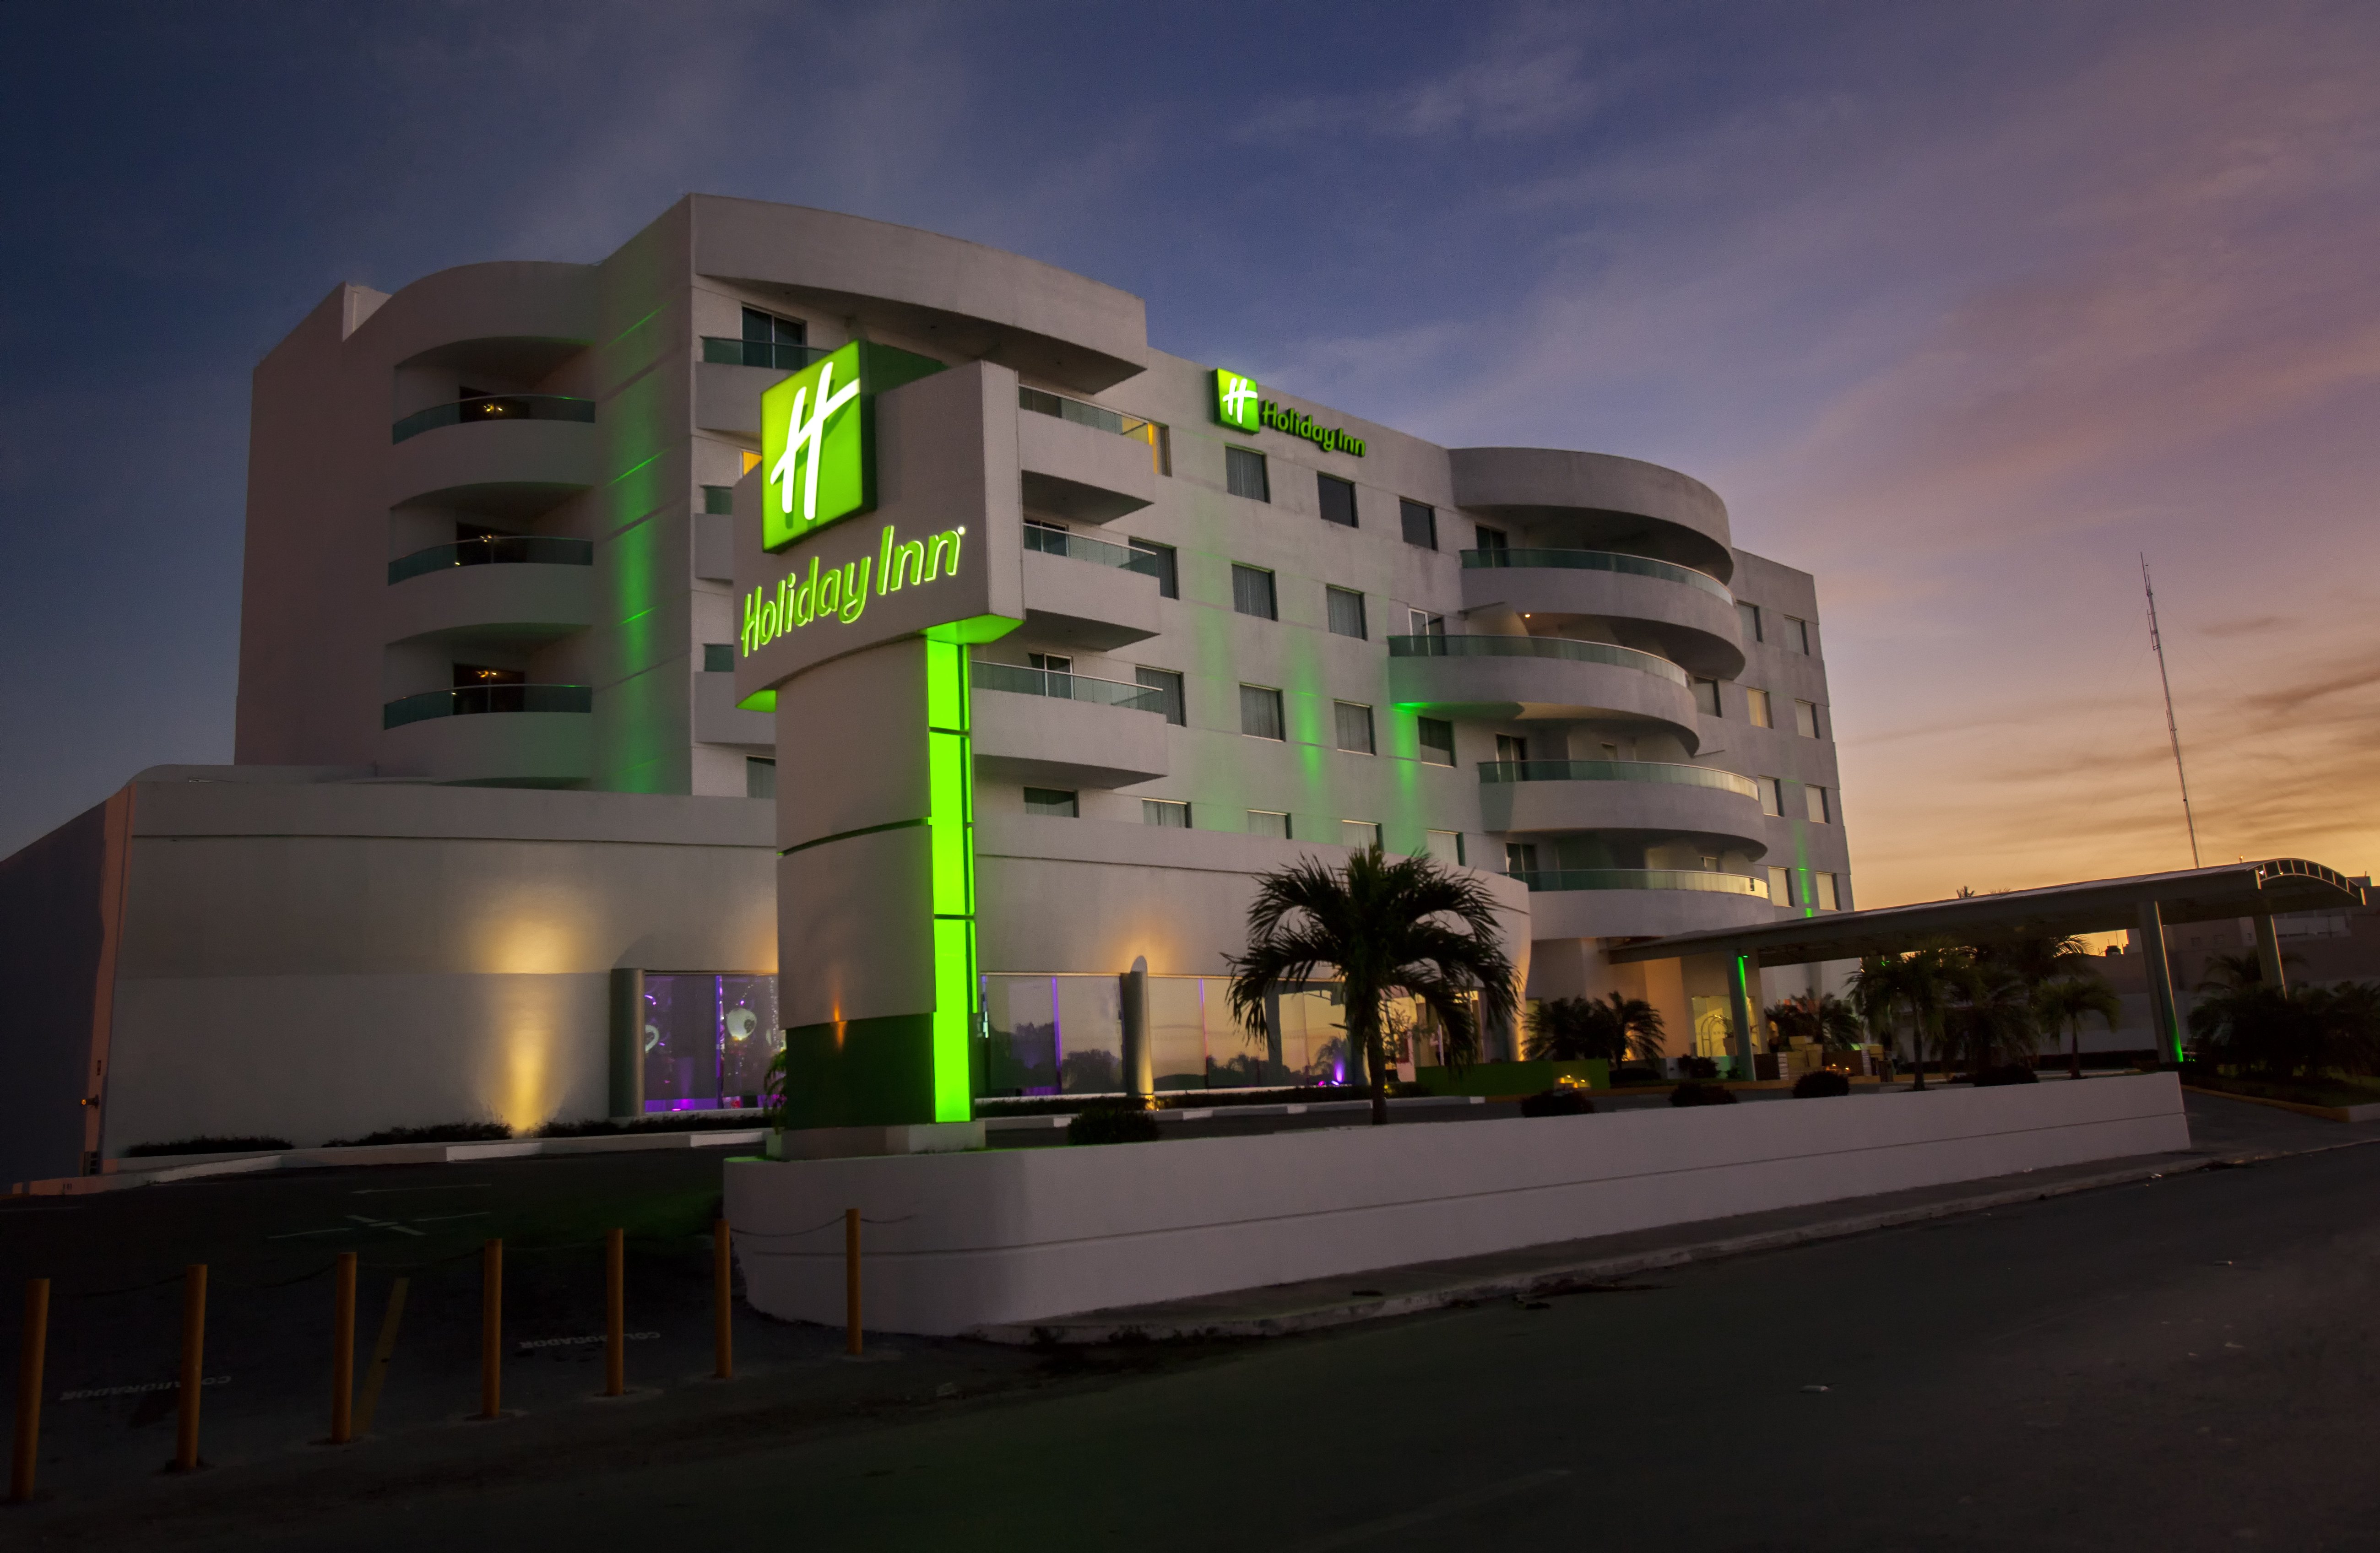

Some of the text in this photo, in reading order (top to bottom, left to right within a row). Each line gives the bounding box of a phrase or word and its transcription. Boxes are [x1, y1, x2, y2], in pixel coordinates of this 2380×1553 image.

[1263, 399, 1366, 457] Holiday Inn
[741, 525, 960, 657] Holiday Inn
[520, 1331, 661, 1349] COLBORADOR
